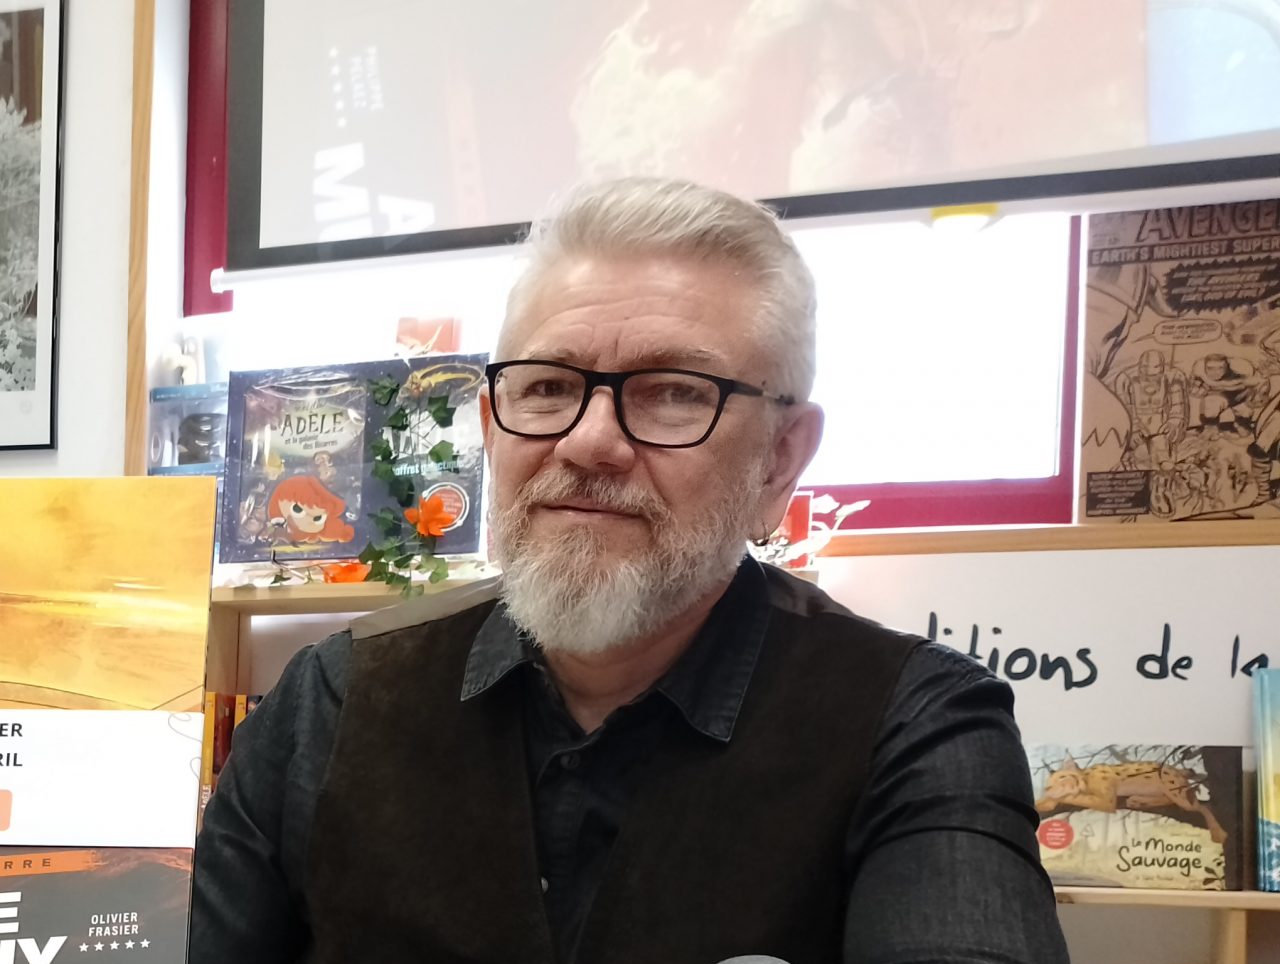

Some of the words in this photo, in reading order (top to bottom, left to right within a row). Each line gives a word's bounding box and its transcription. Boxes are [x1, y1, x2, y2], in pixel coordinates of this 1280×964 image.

[1136, 623, 1193, 681] de
[1145, 837, 1202, 853] Monde
[1116, 845, 1202, 877] Sauvage
[91, 911, 139, 925] OLIVIER
[88, 924, 140, 938] FRASIER
